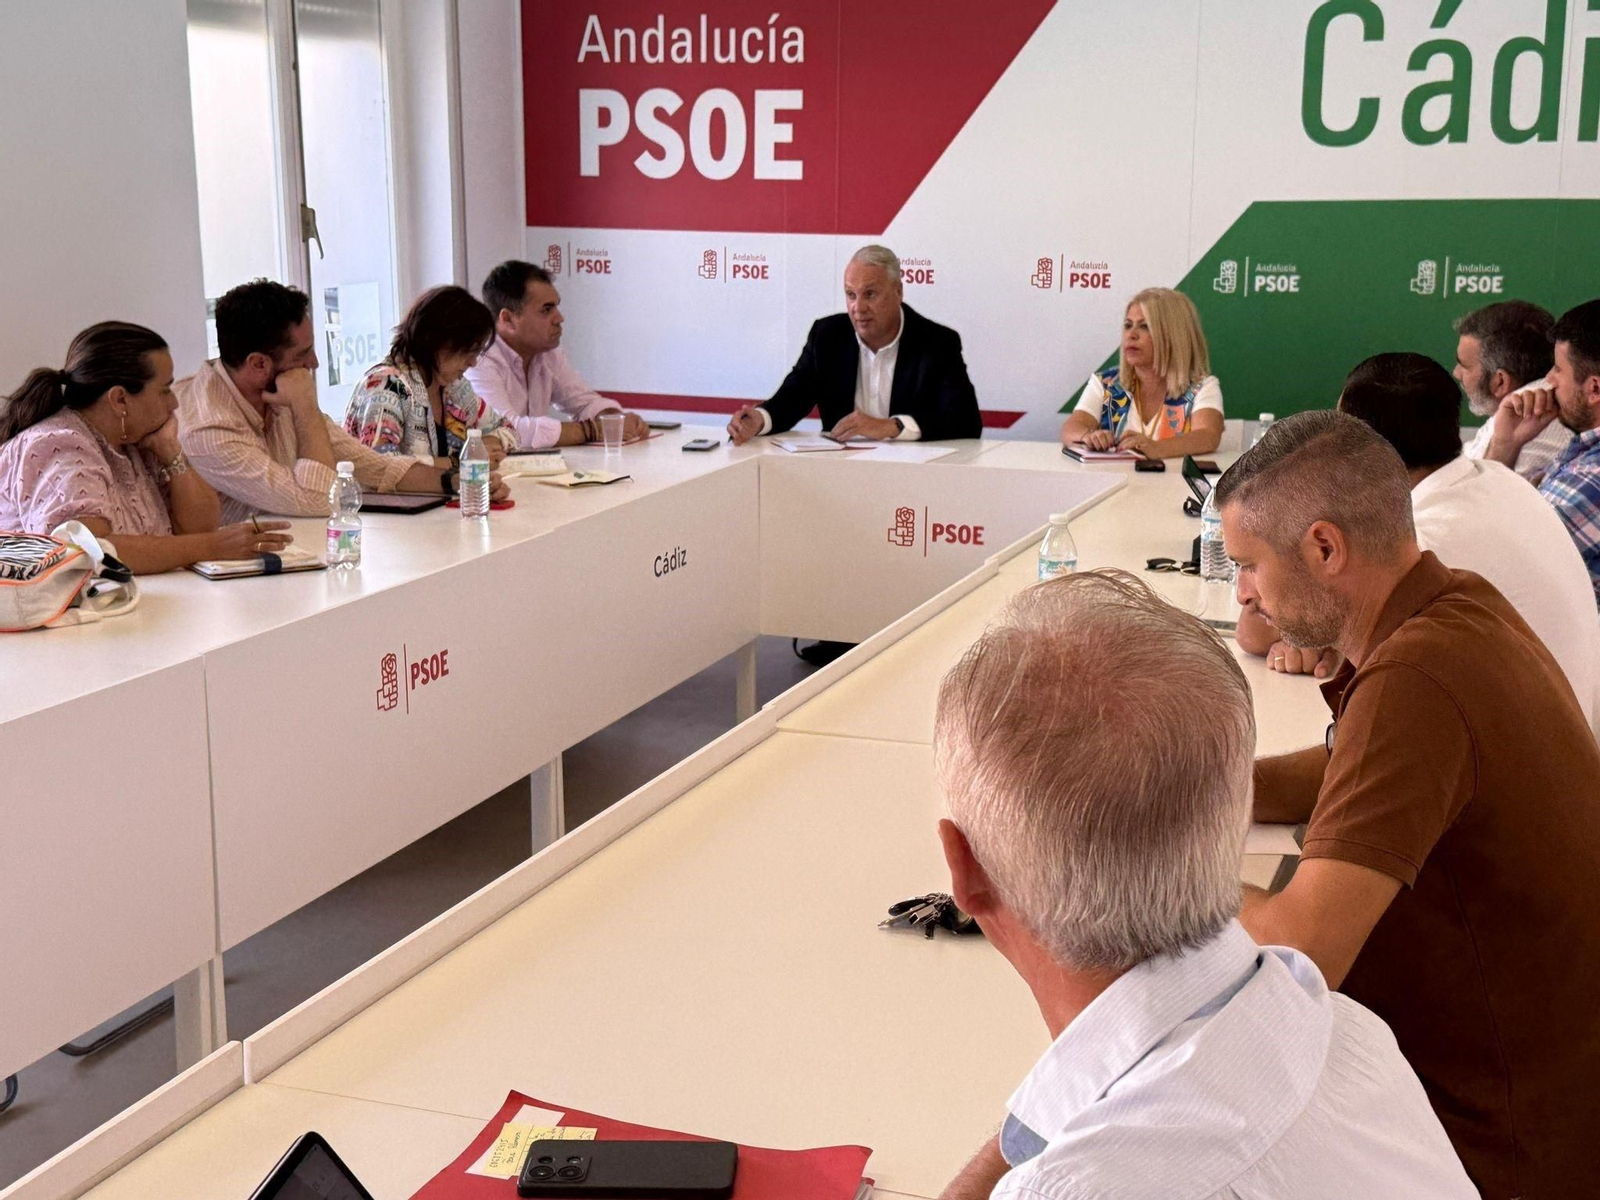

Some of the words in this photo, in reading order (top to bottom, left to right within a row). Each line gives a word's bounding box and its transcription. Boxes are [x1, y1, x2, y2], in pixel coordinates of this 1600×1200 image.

[578, 13, 805, 63] Andalucía
[579, 87, 804, 180] PSOE
[576, 248, 608, 257] Andalucía
[733, 253, 767, 262] Andalucía
[577, 259, 612, 274] PSOE
[733, 264, 769, 280] PSOE
[1070, 260, 1109, 270] Andalucía
[1255, 263, 1297, 273] Andalucía
[1456, 263, 1501, 273] Andalucía
[1069, 272, 1111, 289] PSOE
[1254, 275, 1301, 292] PSOE
[1455, 275, 1504, 294] PSOE
[332, 333, 378, 369] PSOE
[931, 522, 985, 546] PSOE
[653, 547, 688, 578] Cádiz
[410, 649, 449, 689] PSOE
